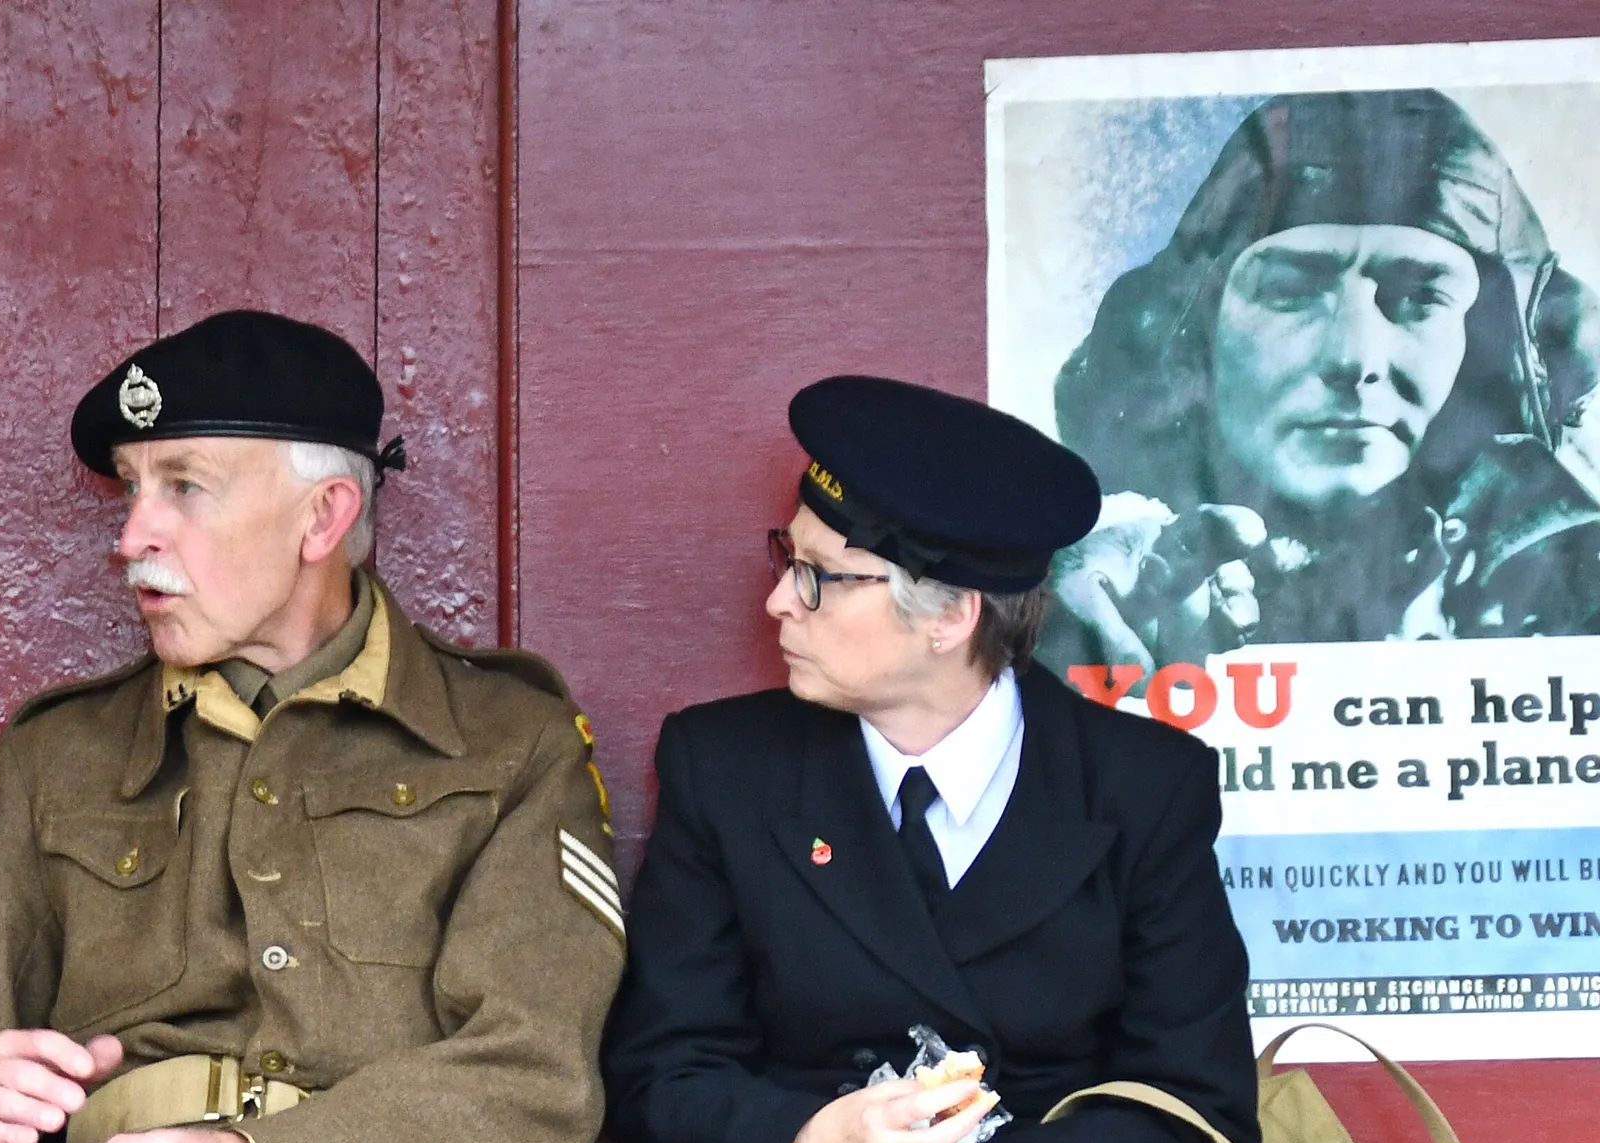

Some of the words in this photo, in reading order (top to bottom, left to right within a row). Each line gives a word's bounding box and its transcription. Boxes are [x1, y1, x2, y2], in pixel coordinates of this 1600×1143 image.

[1067, 662, 1298, 732] YOU
[1333, 695, 1444, 727] can
[1470, 675, 1600, 736] help
[1221, 746, 1275, 792] ld
[1291, 760, 1378, 791] me
[1396, 758, 1431, 788] a
[1447, 740, 1600, 801] plane
[1284, 864, 1390, 893] QUICKLY
[1397, 862, 1447, 886] AND
[1453, 860, 1502, 884] YOU
[1511, 858, 1570, 883] WILL
[1579, 857, 1600, 881] B
[1272, 915, 1460, 943] WORKING
[1470, 913, 1523, 940] TO
[1251, 981, 1377, 998] EMPLOYMENT
[1388, 978, 1484, 996] EXCHANGE
[1496, 977, 1532, 994] FOR
[1355, 997, 1368, 1012] A
[1376, 996, 1411, 1012] JOB
[1421, 995, 1440, 1011] IS
[1449, 993, 1525, 1010] WAITING
[1535, 992, 1568, 1009] FOR
